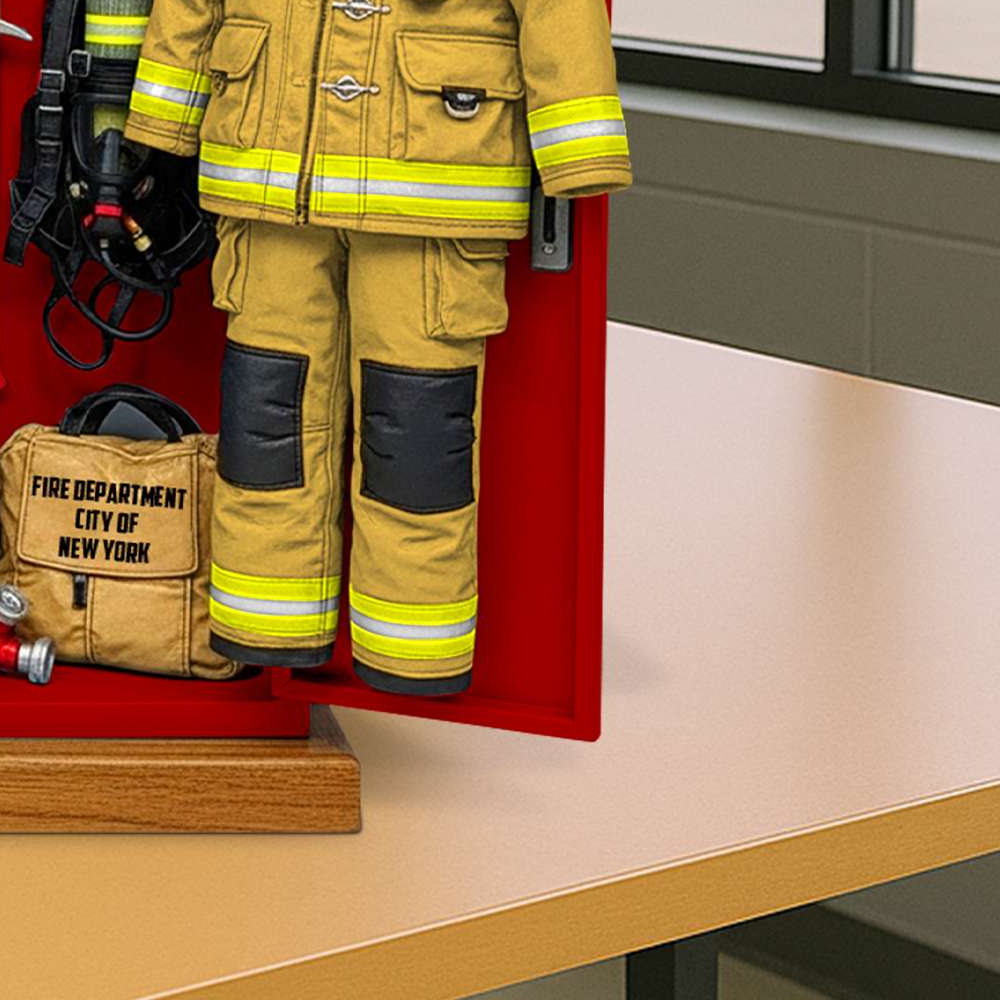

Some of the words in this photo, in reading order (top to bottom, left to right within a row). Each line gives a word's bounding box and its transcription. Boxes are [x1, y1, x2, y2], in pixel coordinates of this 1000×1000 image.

[31, 475, 71, 500] FIRE
[73, 480, 188, 510] DEPARTMENT
[74, 508, 114, 533] CITY
[116, 512, 140, 534] OF
[57, 536, 100, 560] NEW
[103, 539, 151, 564] YORK
